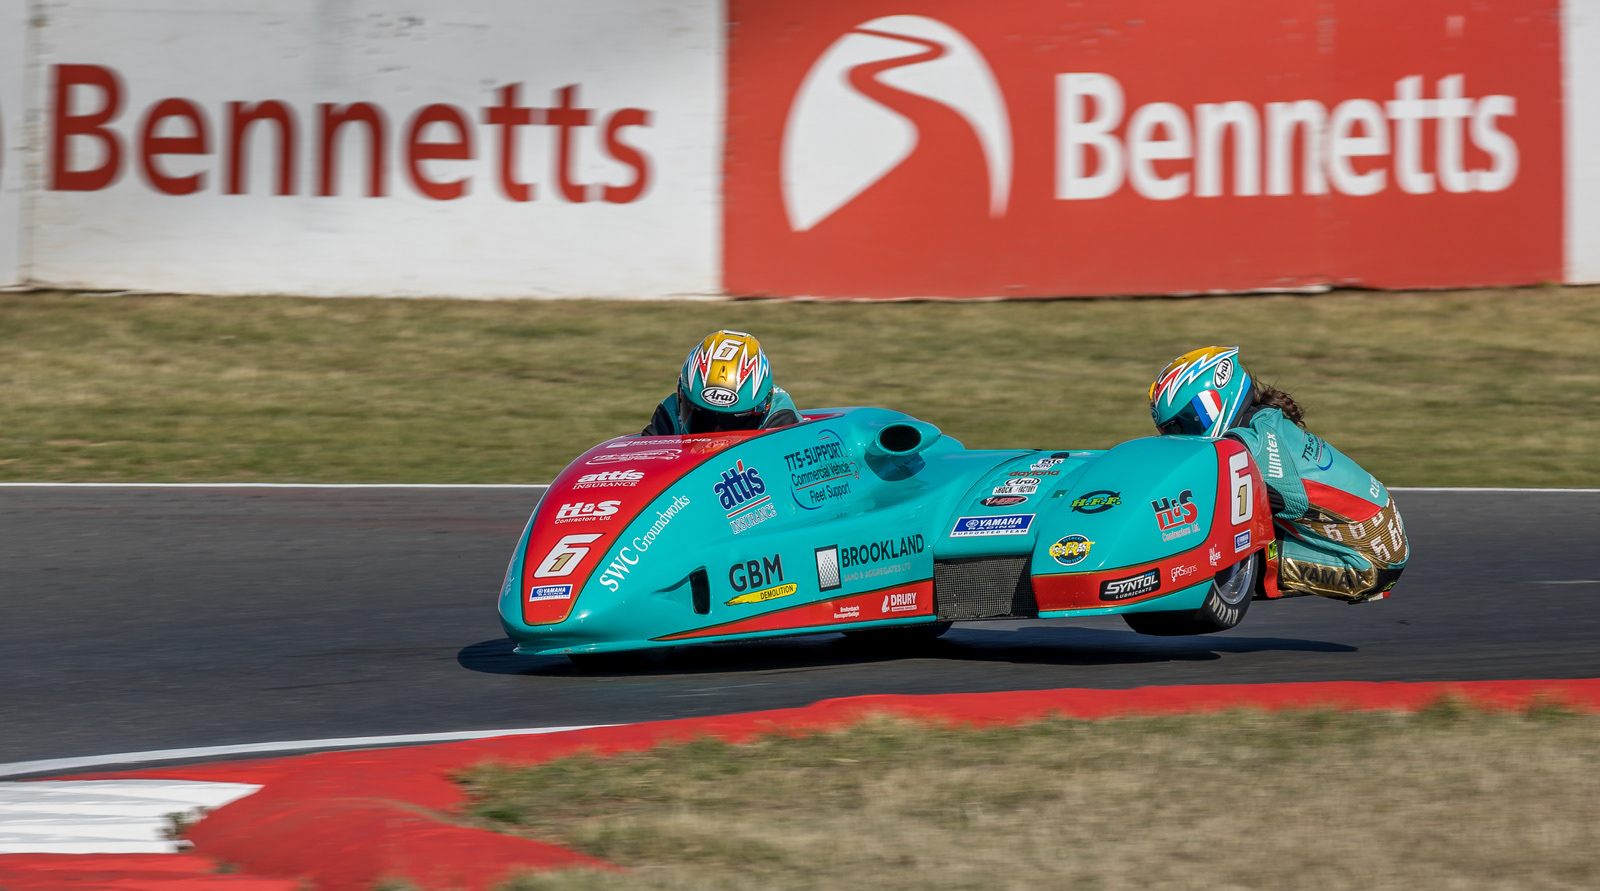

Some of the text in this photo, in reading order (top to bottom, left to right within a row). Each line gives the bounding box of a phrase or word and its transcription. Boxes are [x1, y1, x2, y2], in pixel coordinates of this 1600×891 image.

[47, 63, 656, 204] Bennetts
[1054, 72, 1520, 200] Bennetts
[1216, 361, 1230, 385] Arai
[705, 389, 734, 402] Arai
[784, 441, 844, 472] TTS-SUPPORT
[577, 469, 645, 482] attis
[791, 460, 851, 487] Commercial Vehicle
[572, 480, 638, 490] INSURANCE
[713, 459, 766, 511] attis
[809, 480, 852, 504] Fleet Support
[1228, 450, 1254, 527] 6
[555, 499, 622, 519] H&S
[1069, 496, 1123, 508] H.F.F.
[1151, 489, 1198, 531] H&S
[554, 516, 597, 525] Contractors
[730, 503, 777, 535] INSURANCE
[979, 517, 1023, 527] YAMAHA
[599, 546, 640, 593] SWC
[632, 494, 691, 552] Groundworks
[1162, 525, 1191, 542] Contractors
[533, 532, 606, 579] 6
[841, 533, 925, 569] BROOKLAND
[728, 553, 785, 593] GBM
[843, 573, 859, 582] SAND
[864, 564, 902, 579] AGGREGATES
[901, 562, 912, 572] LTD
[543, 586, 567, 594] YAMAHA
[760, 584, 795, 600] DEMOLITION
[1103, 574, 1159, 595] SYNTOL
[1115, 586, 1152, 600] LUBRICANTS
[890, 592, 918, 606] DRURY
